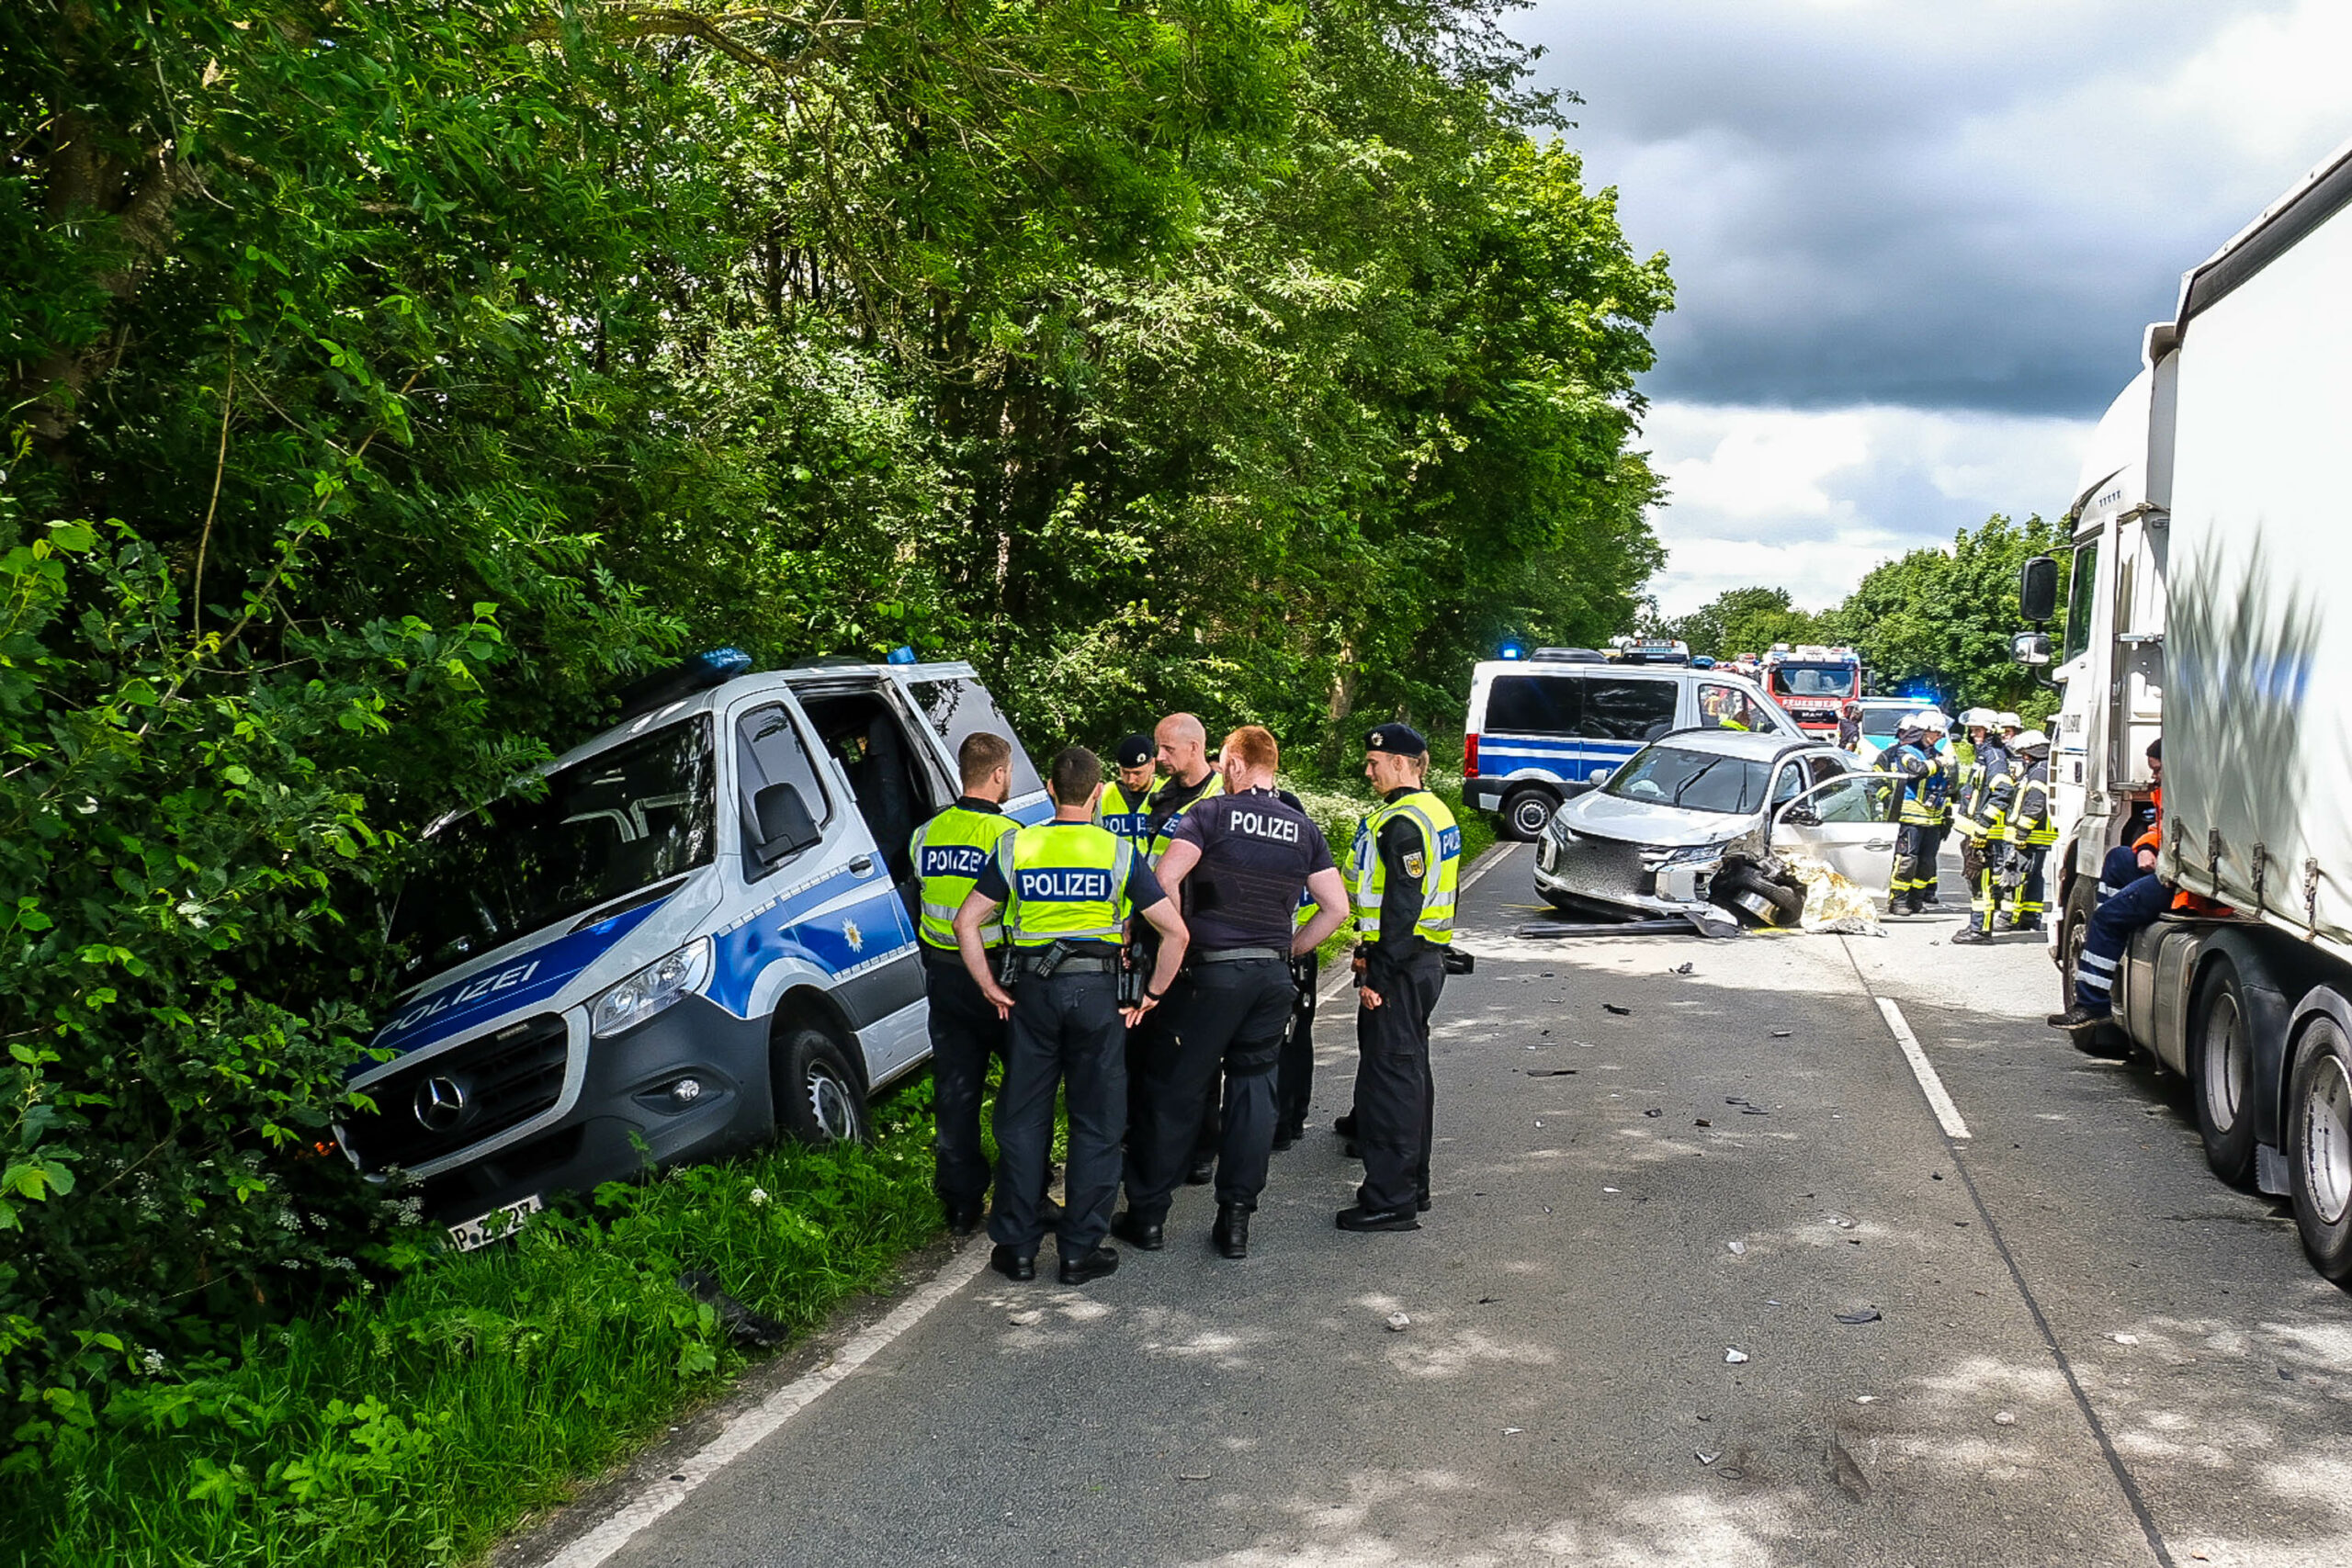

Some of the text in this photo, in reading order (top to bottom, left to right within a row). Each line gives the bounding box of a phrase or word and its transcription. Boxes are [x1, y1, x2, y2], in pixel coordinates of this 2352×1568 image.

[1230, 809, 1299, 843] POLIZEI
[1022, 874, 1105, 897] POLIZEI
[370, 960, 541, 1047] POLIZEI
